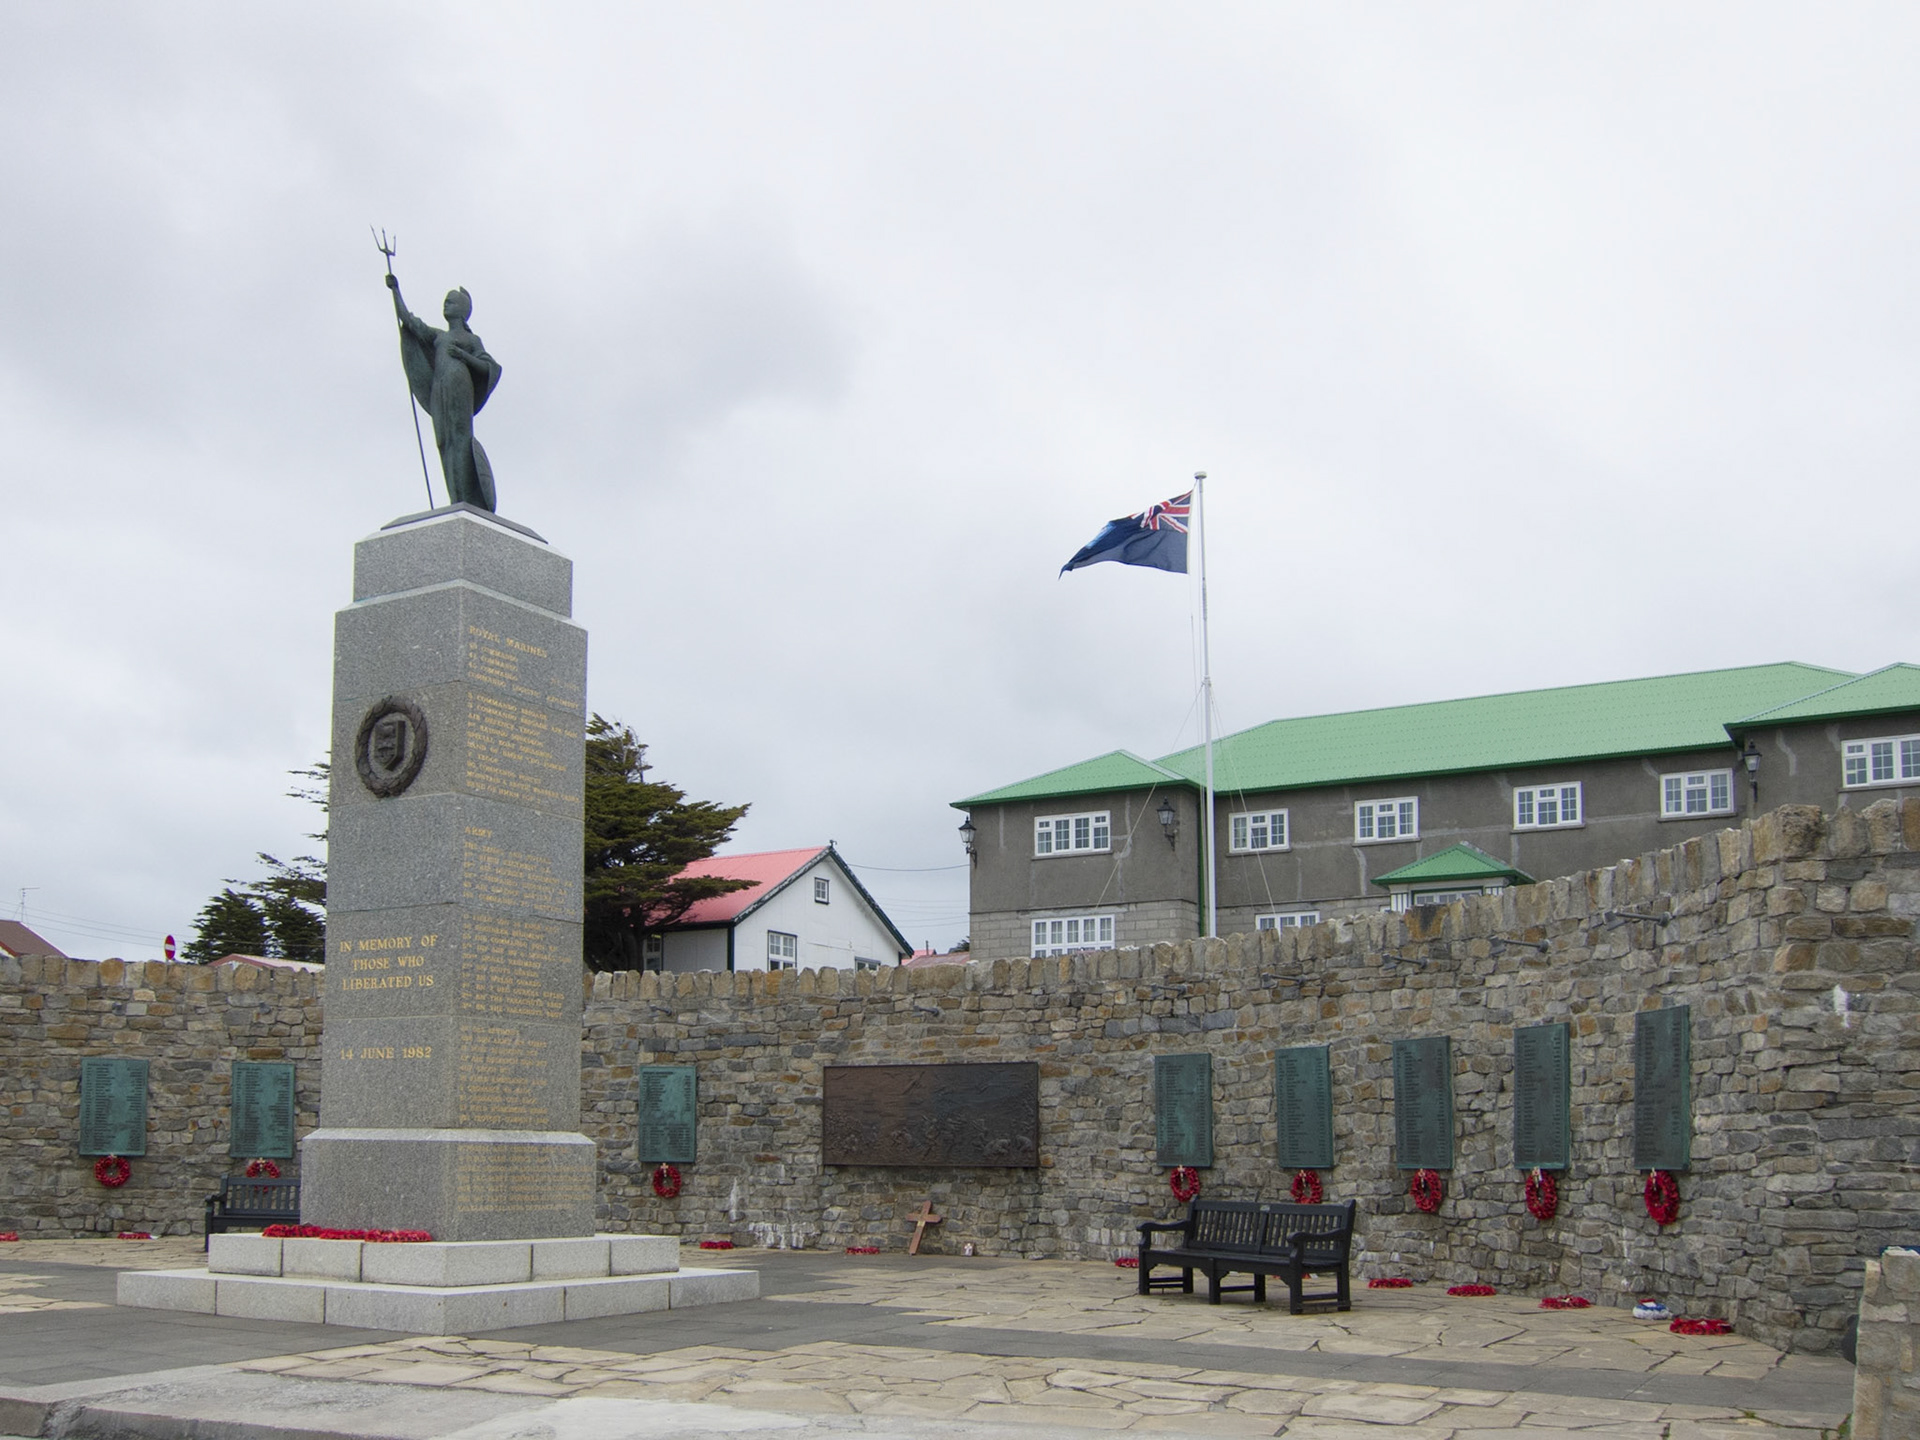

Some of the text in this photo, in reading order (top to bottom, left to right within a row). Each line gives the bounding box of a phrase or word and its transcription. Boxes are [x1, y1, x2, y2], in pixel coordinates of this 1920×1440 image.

[469, 625, 548, 658] ROYAL MARINES
[464, 826, 493, 838] ARMY
[340, 934, 439, 953] IN MEMORY OF
[352, 955, 425, 971] THOSE WHO
[342, 974, 435, 991] LIBERATED US
[340, 1044, 432, 1061] 14 JUNE 1982
